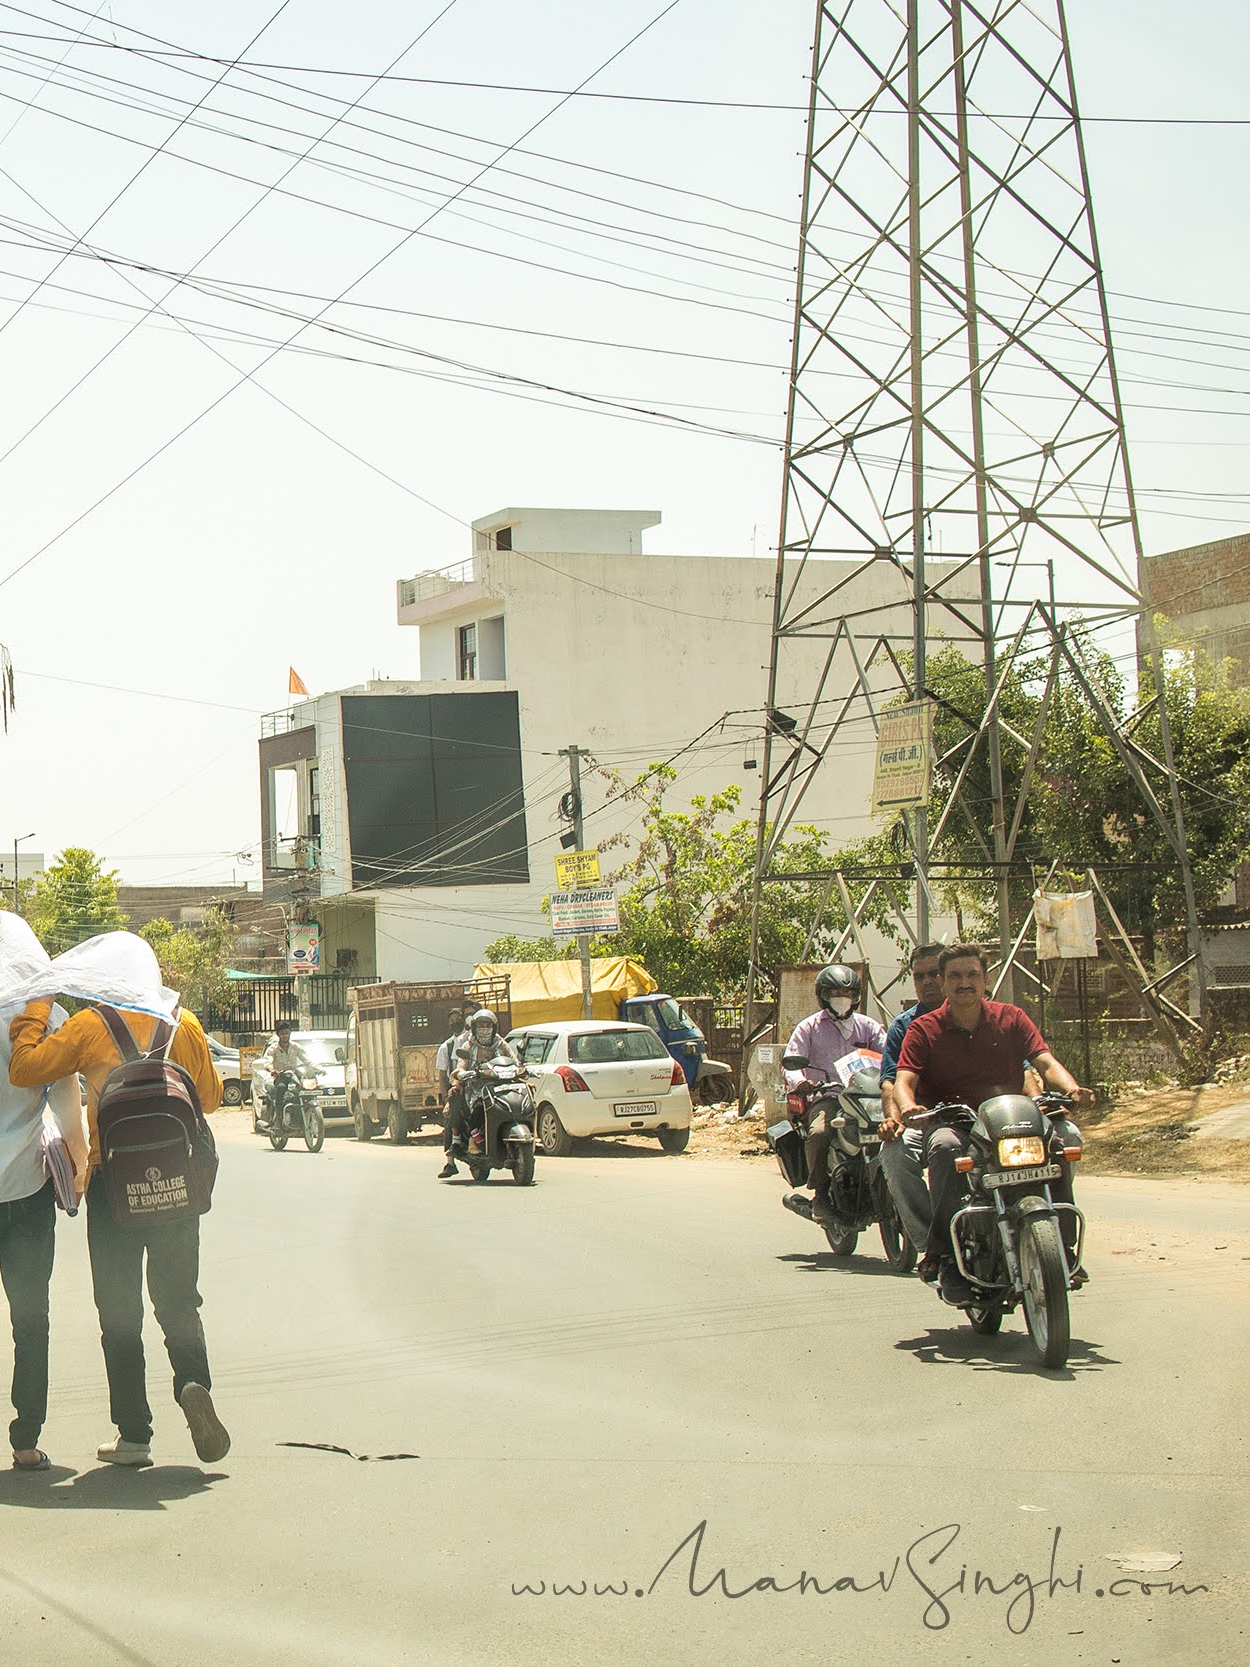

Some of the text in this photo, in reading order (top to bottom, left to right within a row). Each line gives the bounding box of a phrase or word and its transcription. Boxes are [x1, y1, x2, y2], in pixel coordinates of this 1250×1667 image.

[557, 854, 596, 867] SHREE SHYAM
[551, 890, 614, 905] NEHA DRYCLEANERS
[126, 1175, 186, 1196] ASTHA COLLEGE
[128, 1188, 189, 1206] OF EDUCATION
